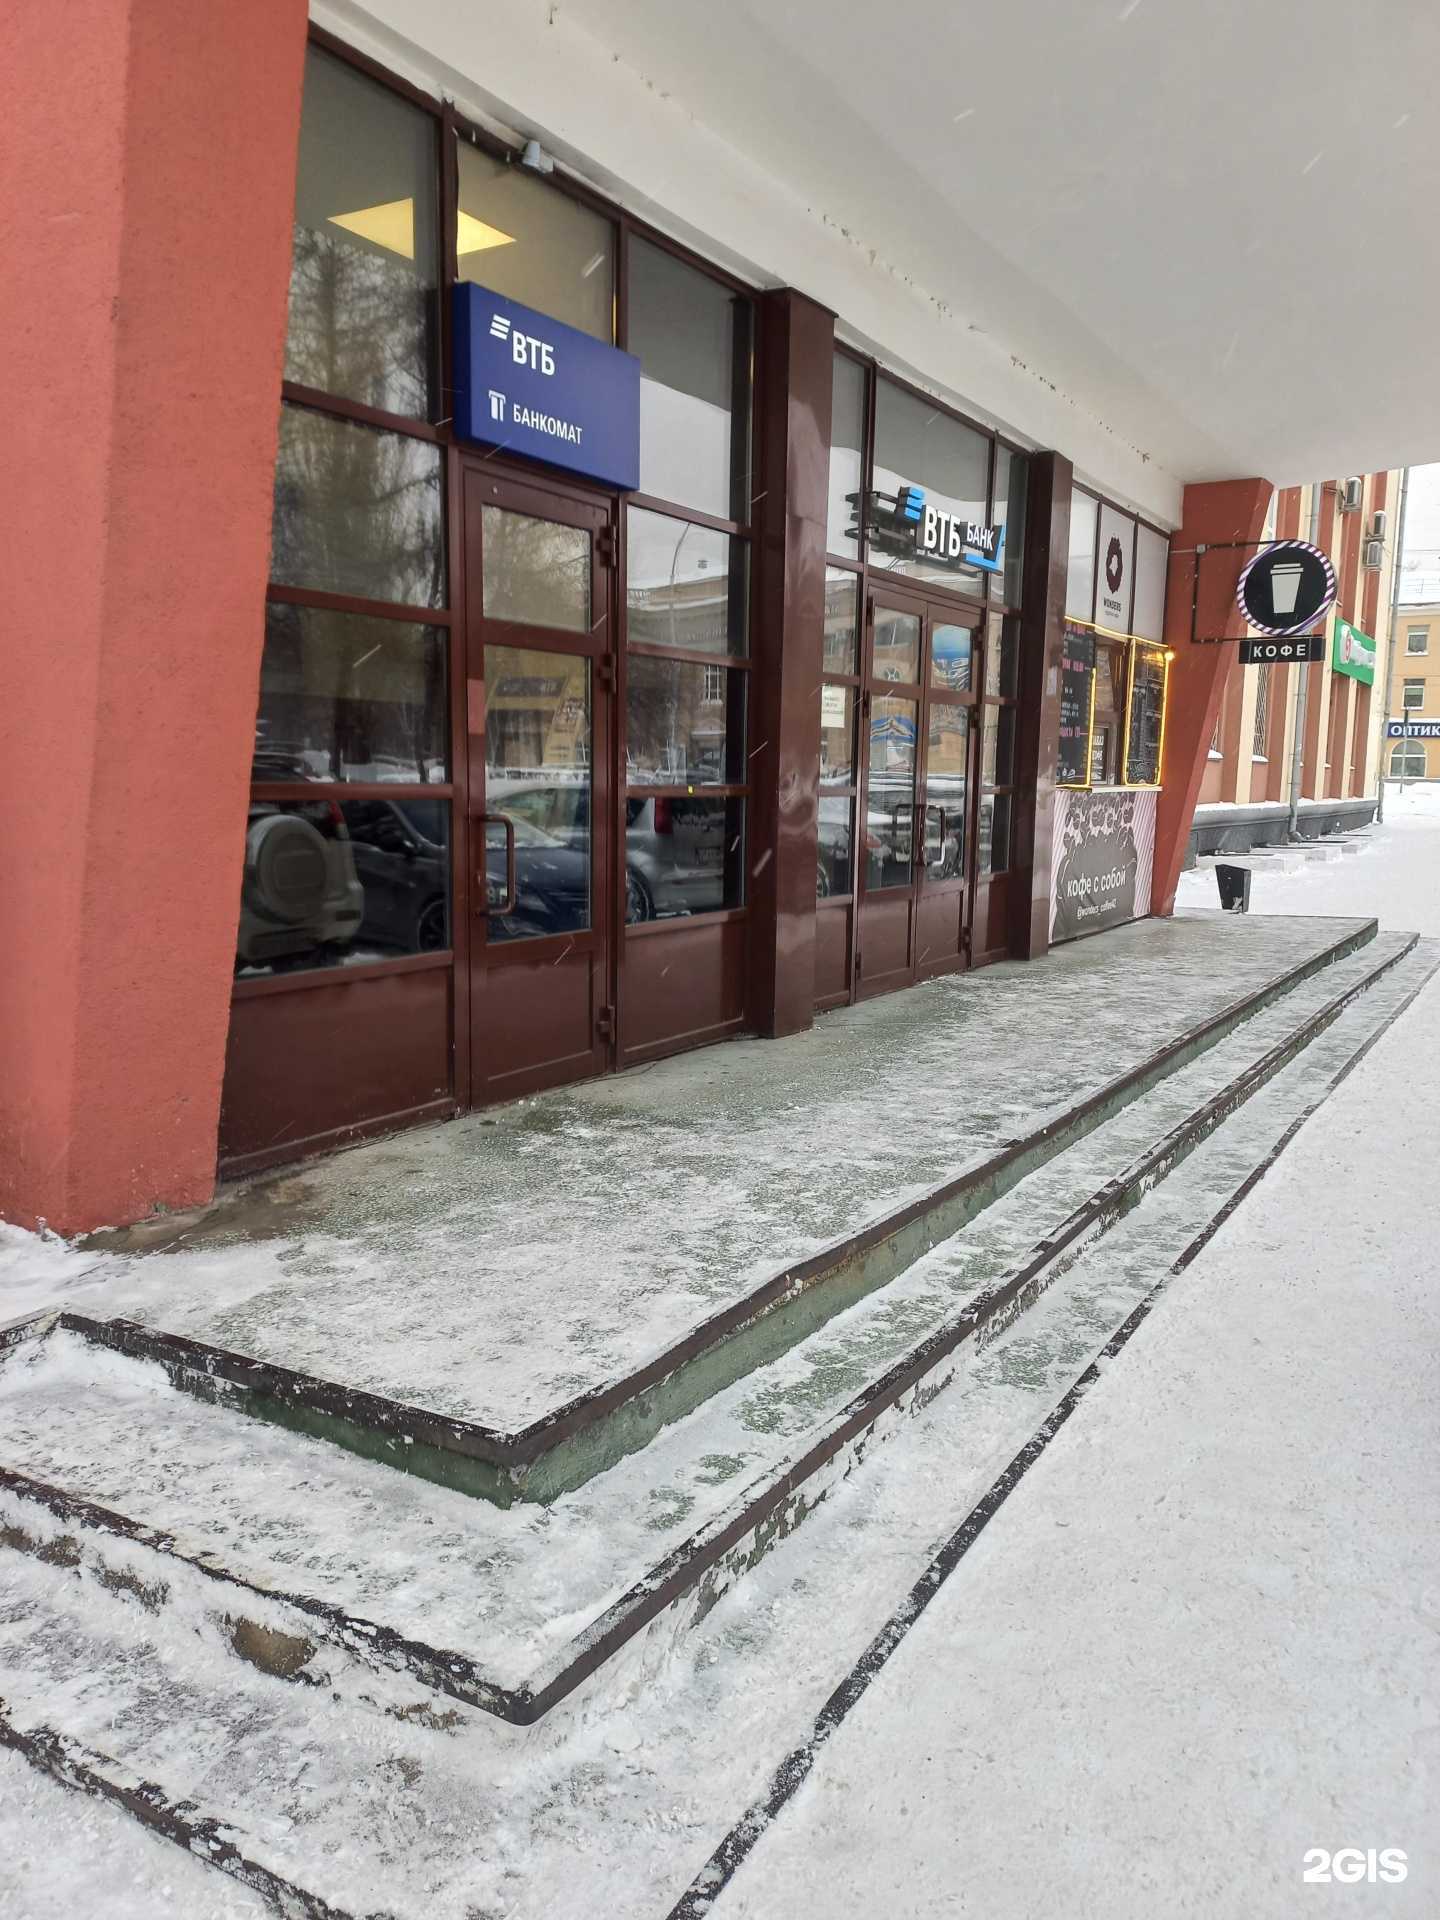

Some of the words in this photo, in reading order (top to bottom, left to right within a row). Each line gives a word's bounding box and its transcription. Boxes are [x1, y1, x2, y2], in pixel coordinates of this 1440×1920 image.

[512, 330, 556, 376] ВТБ
[513, 403, 583, 445] БАНКОМАТ
[923, 505, 961, 557] ВТБ
[966, 521, 995, 551] БАНК
[1253, 644, 1306, 658] КОФЕ
[1067, 872, 1092, 900] кофе
[1093, 876, 1099, 892] с
[1101, 864, 1127, 891] собой
